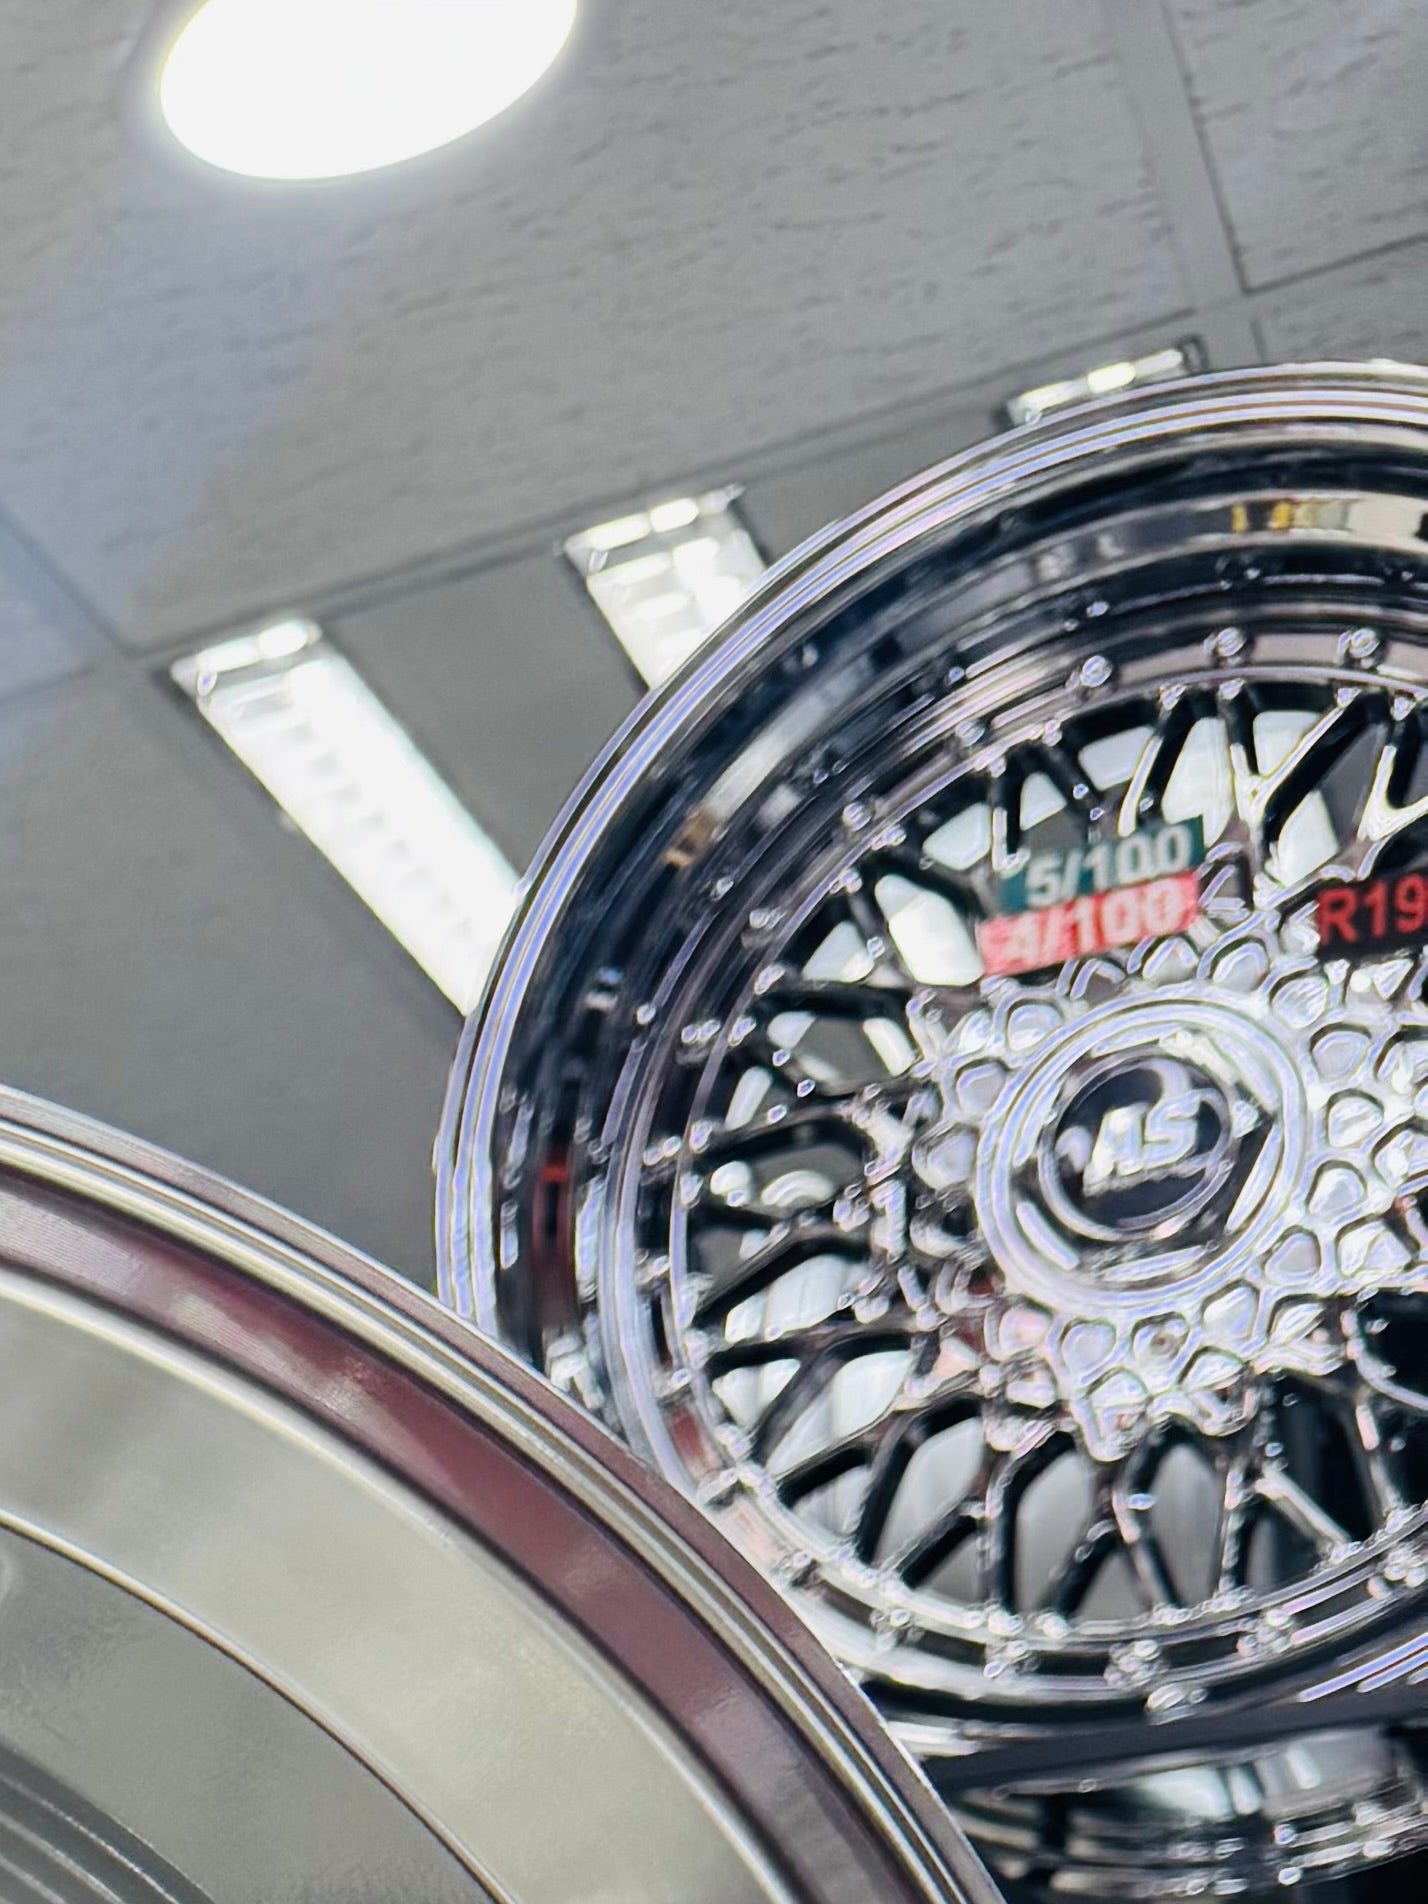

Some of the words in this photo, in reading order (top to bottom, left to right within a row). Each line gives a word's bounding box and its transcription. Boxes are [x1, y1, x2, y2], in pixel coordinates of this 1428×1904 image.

[1025, 825, 1192, 908] 5/100
[1004, 879, 1182, 963] 4/100
[1317, 873, 1428, 947] R19
